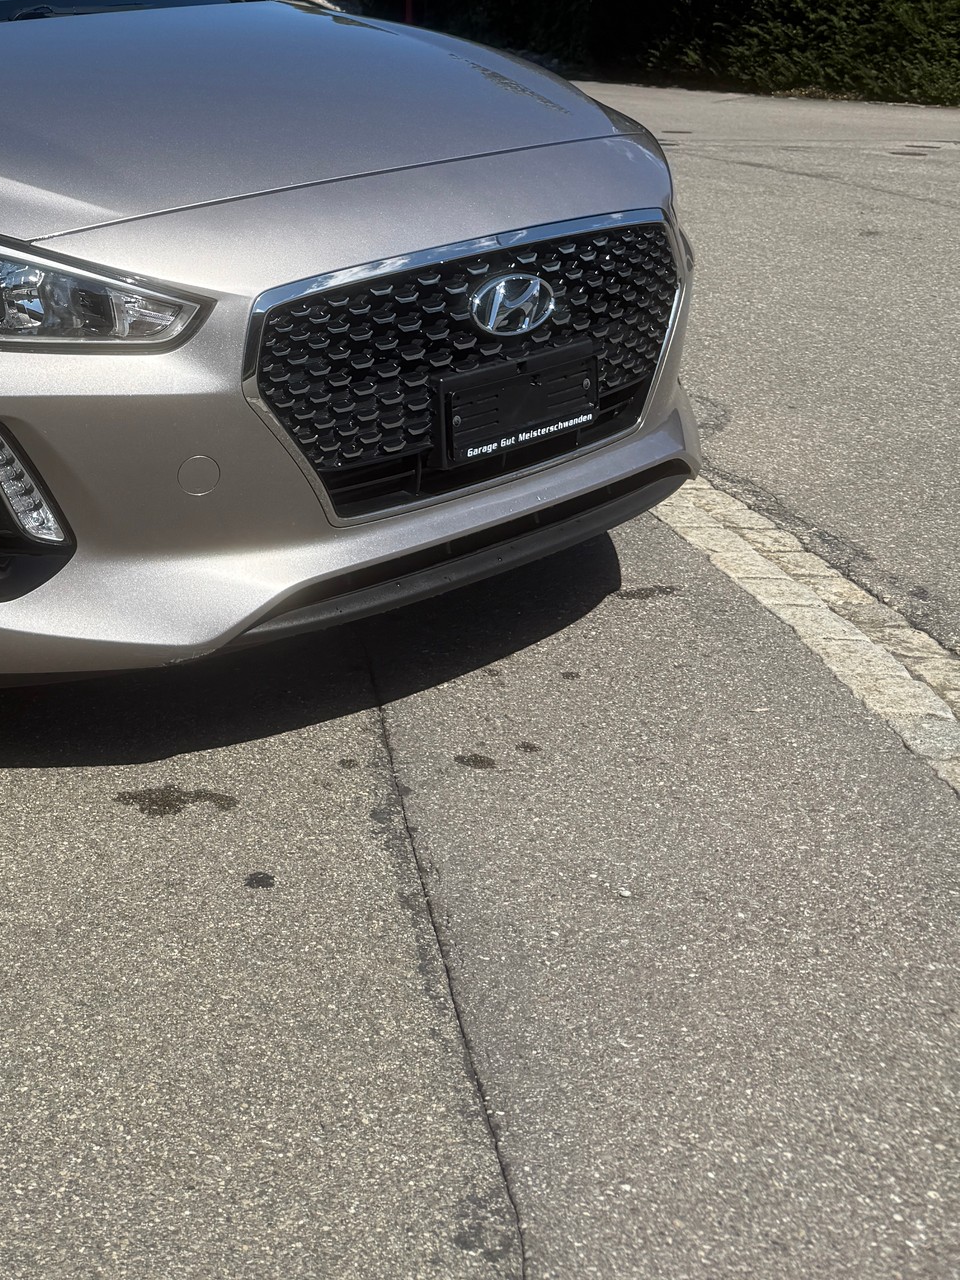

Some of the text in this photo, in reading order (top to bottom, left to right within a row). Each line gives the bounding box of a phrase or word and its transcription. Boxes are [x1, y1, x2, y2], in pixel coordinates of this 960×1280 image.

[467, 413, 593, 457] Garage Gut Meisterschwanden
